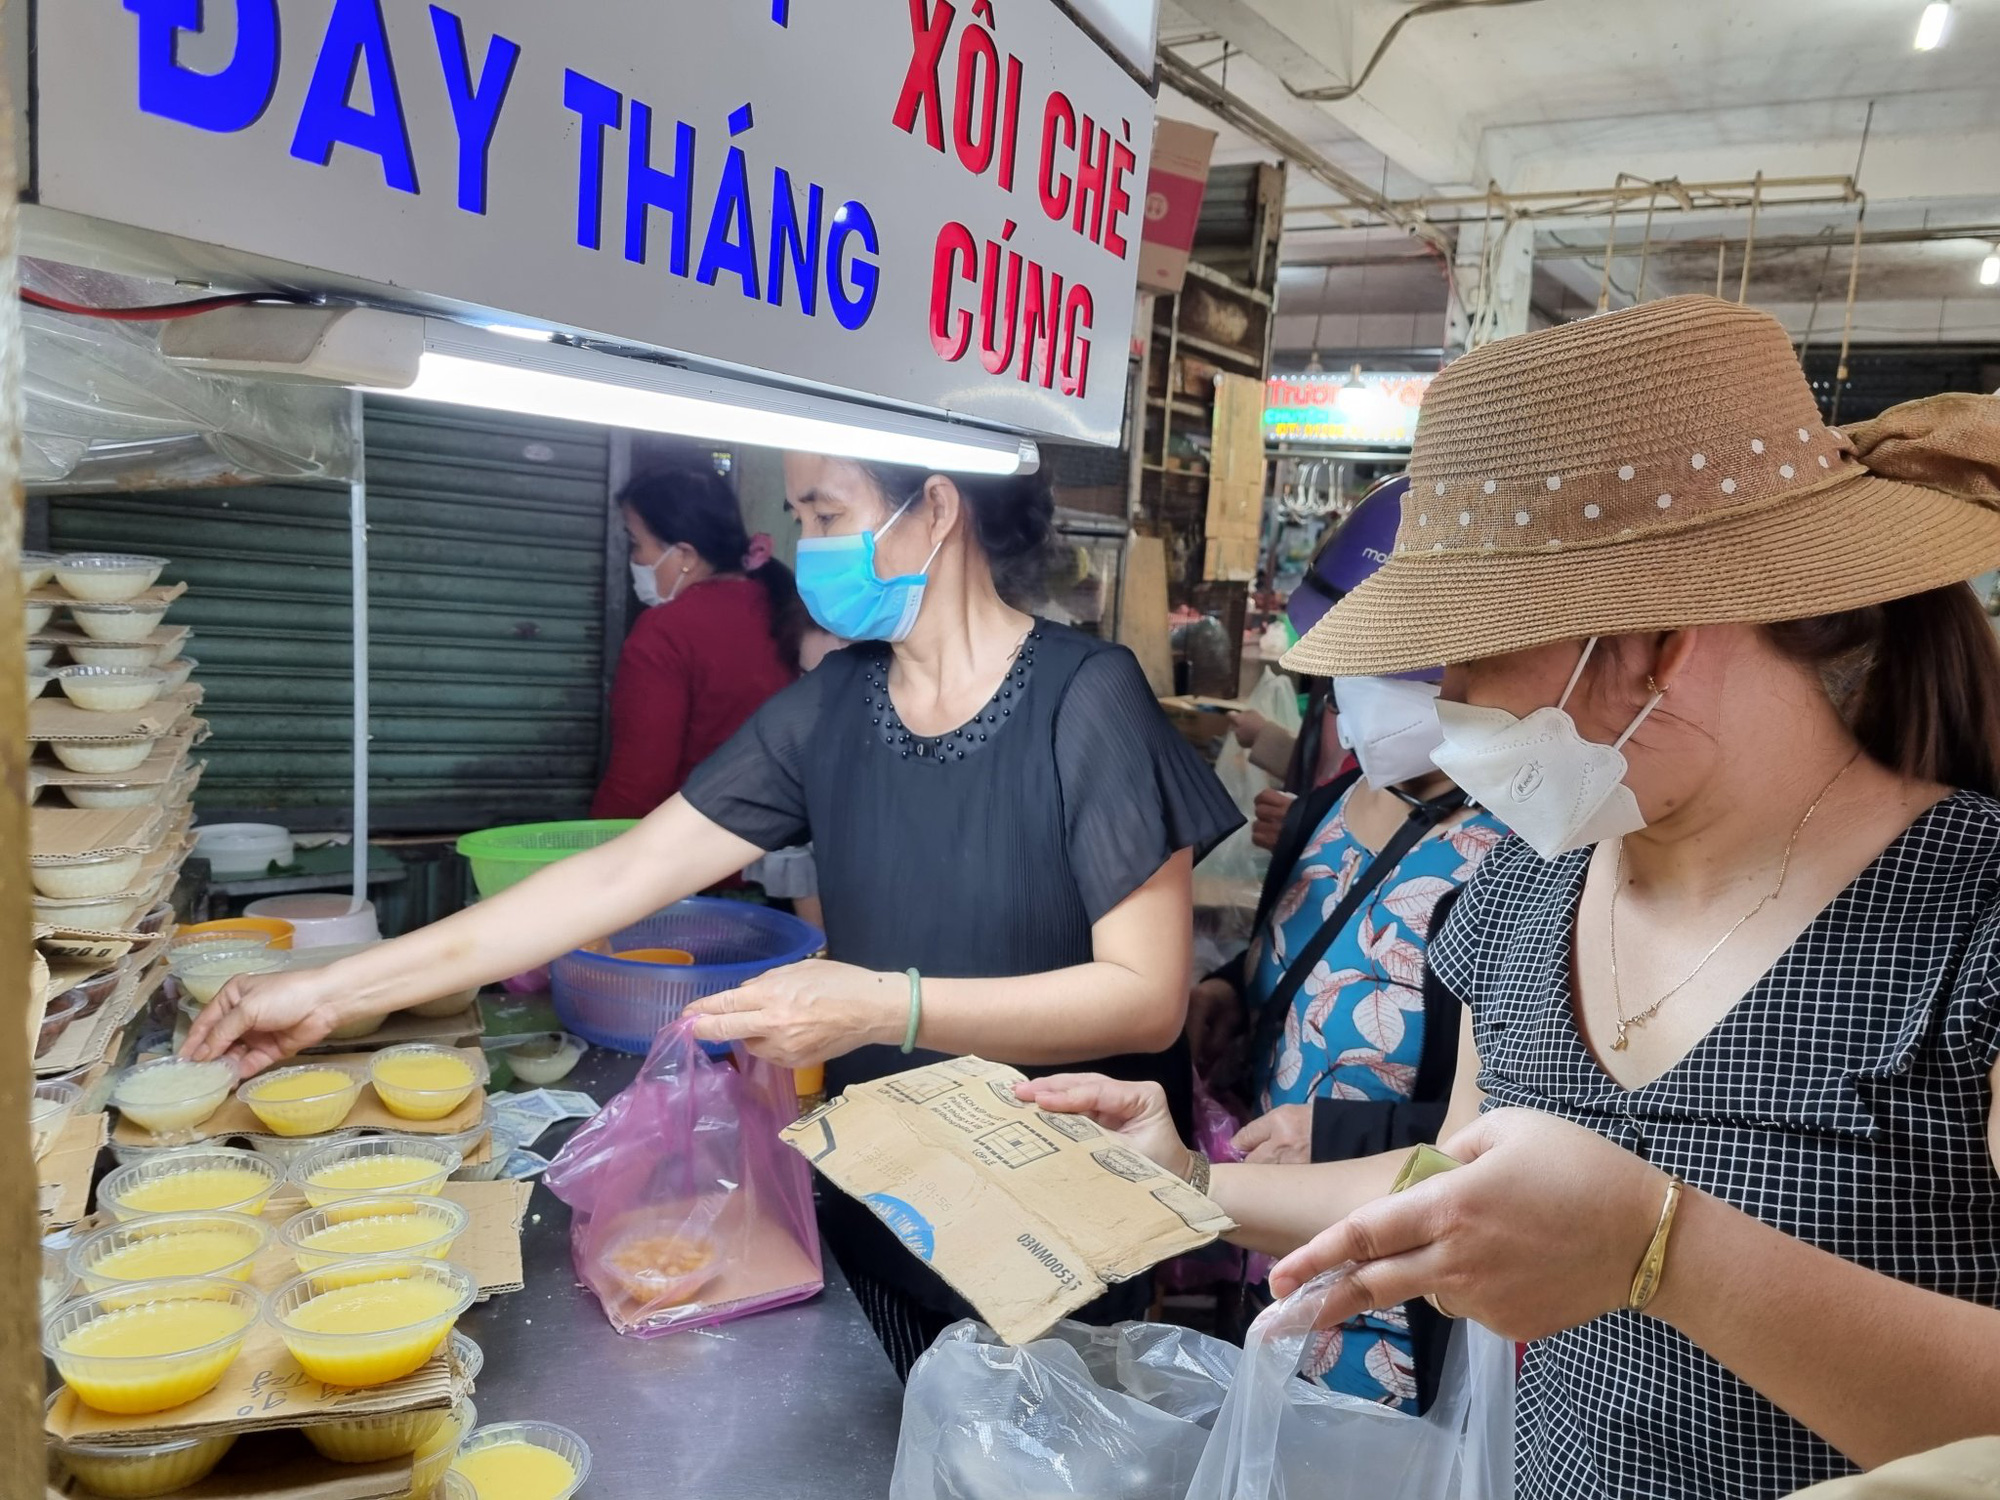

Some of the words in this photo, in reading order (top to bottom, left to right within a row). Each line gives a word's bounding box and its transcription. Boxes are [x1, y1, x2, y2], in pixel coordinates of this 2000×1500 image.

[563, 68, 881, 331] THÁNG
[893, 0, 1023, 193] XÔI
[1038, 91, 1136, 260] CHÈ
[929, 219, 1094, 399] CÚNG
